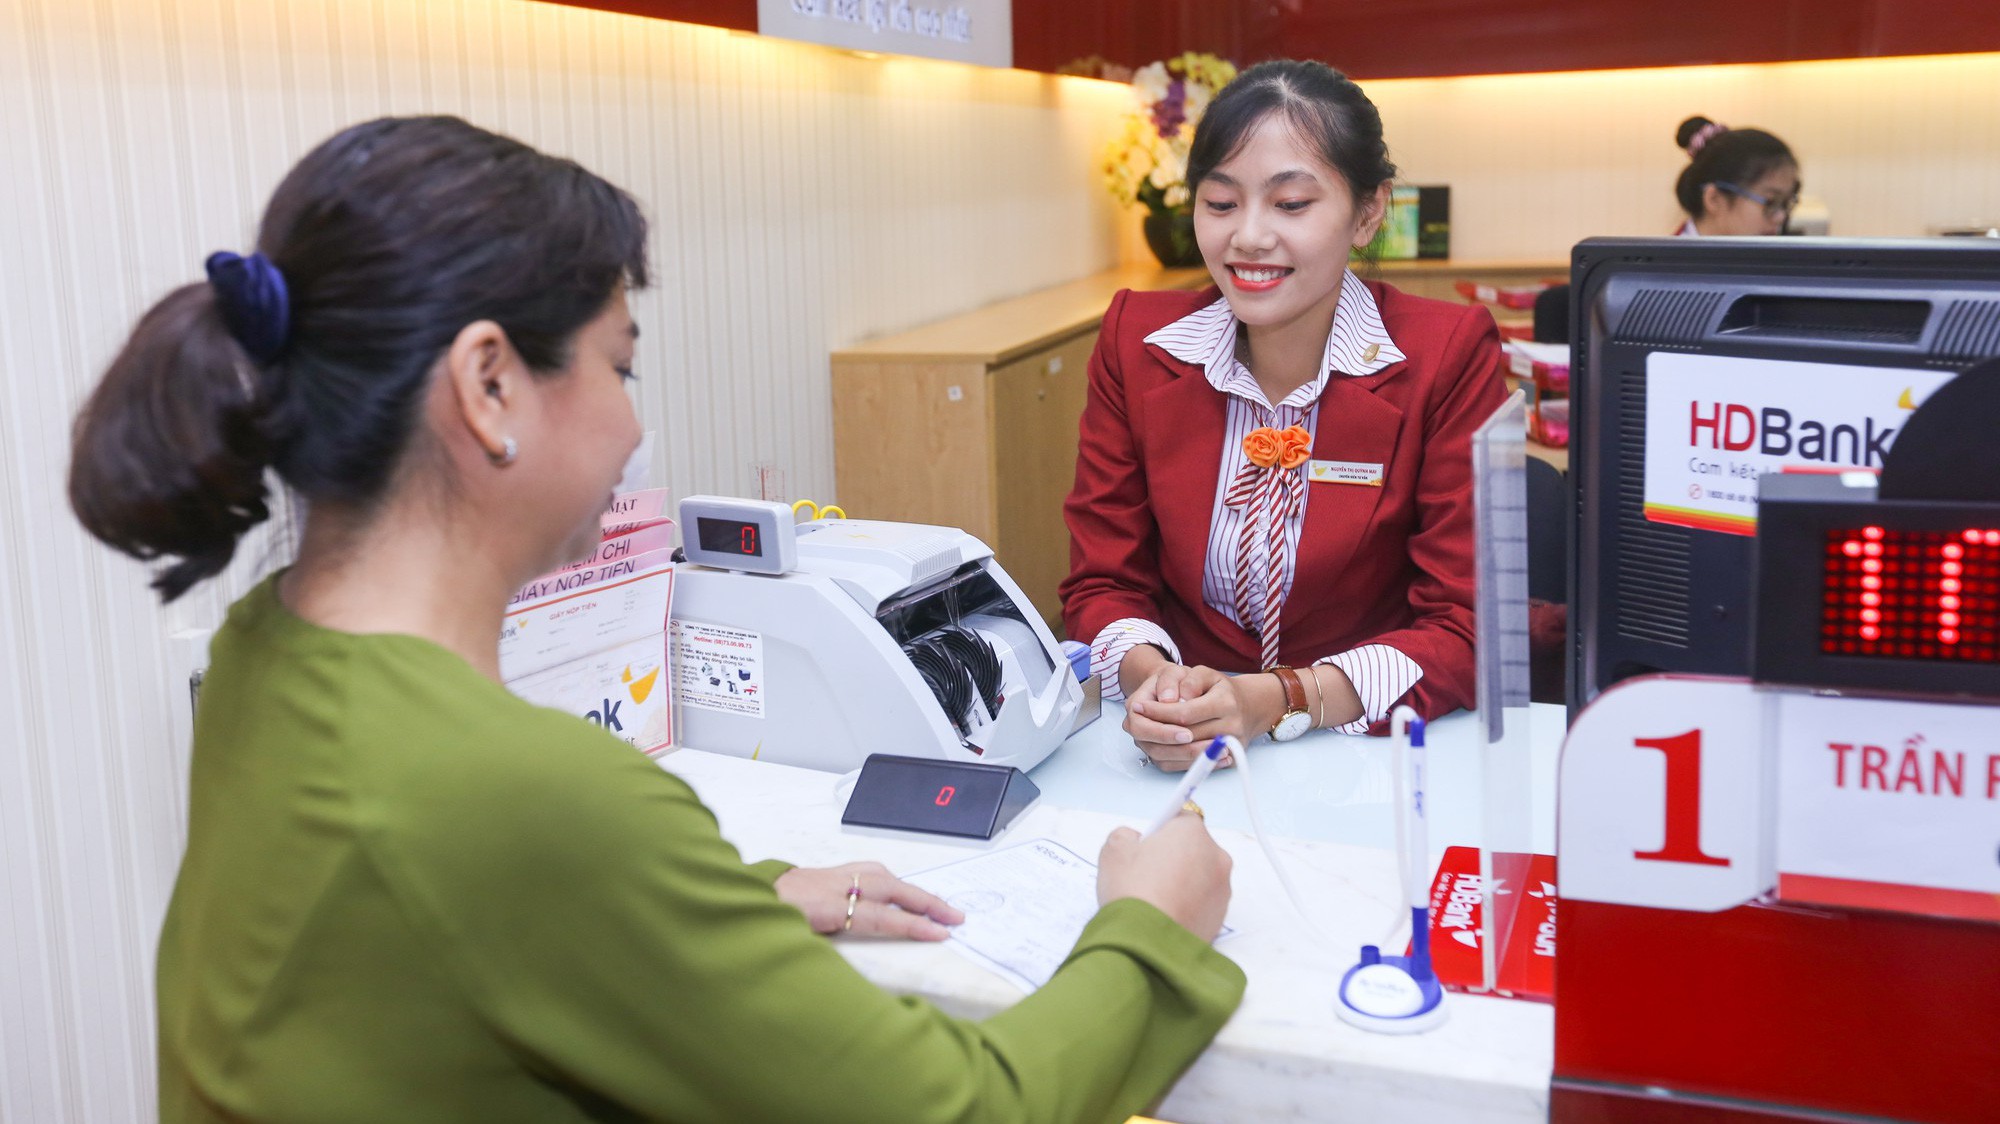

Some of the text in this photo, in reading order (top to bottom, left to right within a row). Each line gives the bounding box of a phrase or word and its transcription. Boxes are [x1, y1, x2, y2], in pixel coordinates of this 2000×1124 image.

[1690, 400, 1894, 467] HDBank
[602, 539, 631, 560] CHI
[741, 525, 755, 554] 0
[1828, 733, 1966, 797] TRẦN
[935, 786, 955, 806] 0
[1633, 728, 1732, 867] 1
